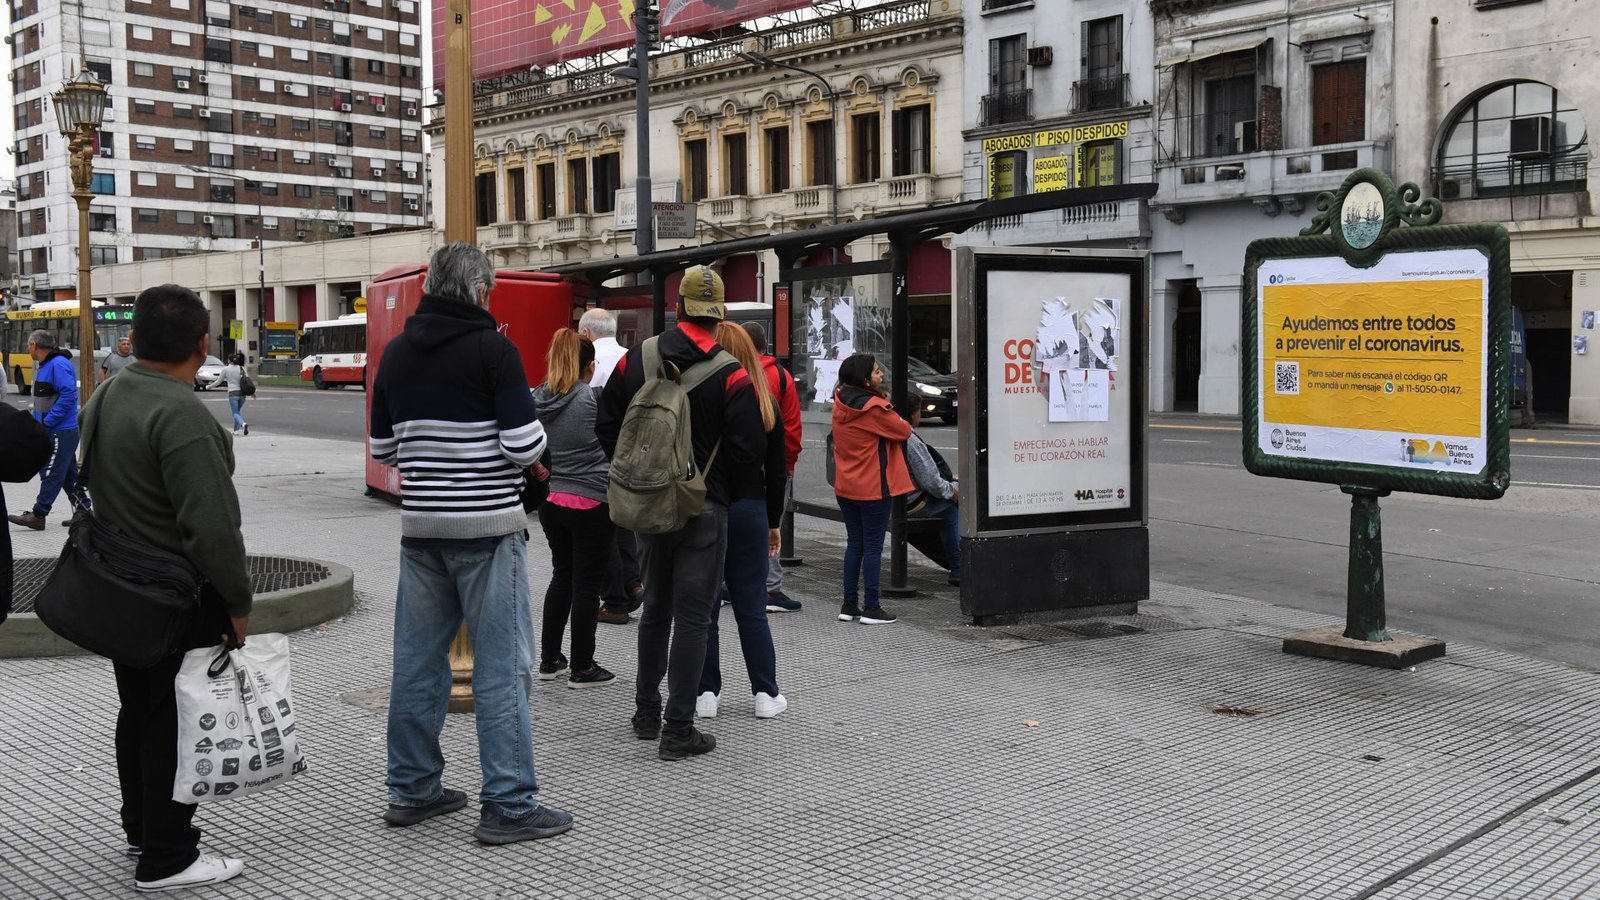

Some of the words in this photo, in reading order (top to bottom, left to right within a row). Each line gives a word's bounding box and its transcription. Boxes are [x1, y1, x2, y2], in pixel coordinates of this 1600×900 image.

[985, 134, 1031, 152] ABOGADOS
[1047, 130, 1070, 144] PISO
[1075, 122, 1127, 141] DESPIDOS
[1035, 158, 1068, 170] ABOGADOS
[1035, 171, 1067, 184] DESPIDOS
[778, 293, 787, 301] 19
[39, 310, 52, 318] 41
[56, 309, 72, 317] ONCE
[104, 311, 117, 320] 41
[1281, 315, 1359, 334] Ayudemos
[1362, 315, 1403, 331] entre
[1406, 313, 1456, 331] todos
[1276, 337, 1283, 350] a
[1286, 334, 1346, 353] prevenir
[1348, 334, 1361, 351] el
[1365, 334, 1465, 353] coronavirus.
[1004, 362, 1033, 385] DE
[1307, 369, 1323, 378] Para
[1324, 370, 1347, 379] saber
[1346, 371, 1361, 379] más
[1362, 371, 1393, 380] escaneá
[1395, 372, 1402, 381] el
[1403, 371, 1432, 383] código
[1433, 373, 1448, 382] QR
[1004, 385, 1048, 395] MUESTRA
[1314, 381, 1339, 390] mandá
[1350, 383, 1382, 393] mensaje
[1397, 383, 1404, 393] al
[1285, 429, 1307, 437] Buenos
[1013, 438, 1067, 451] EMPECEMOS
[1069, 438, 1076, 447] A
[1077, 436, 1109, 448] HABLAR
[1285, 436, 1302, 444] Aires
[1285, 443, 1307, 452] Ciudad
[1444, 442, 1468, 451] Vamos
[1014, 453, 1025, 463] DE
[1028, 452, 1038, 463] TU
[1040, 448, 1086, 462] CORAZÓN
[1448, 450, 1475, 459] Buenos
[1453, 458, 1472, 466] Aires
